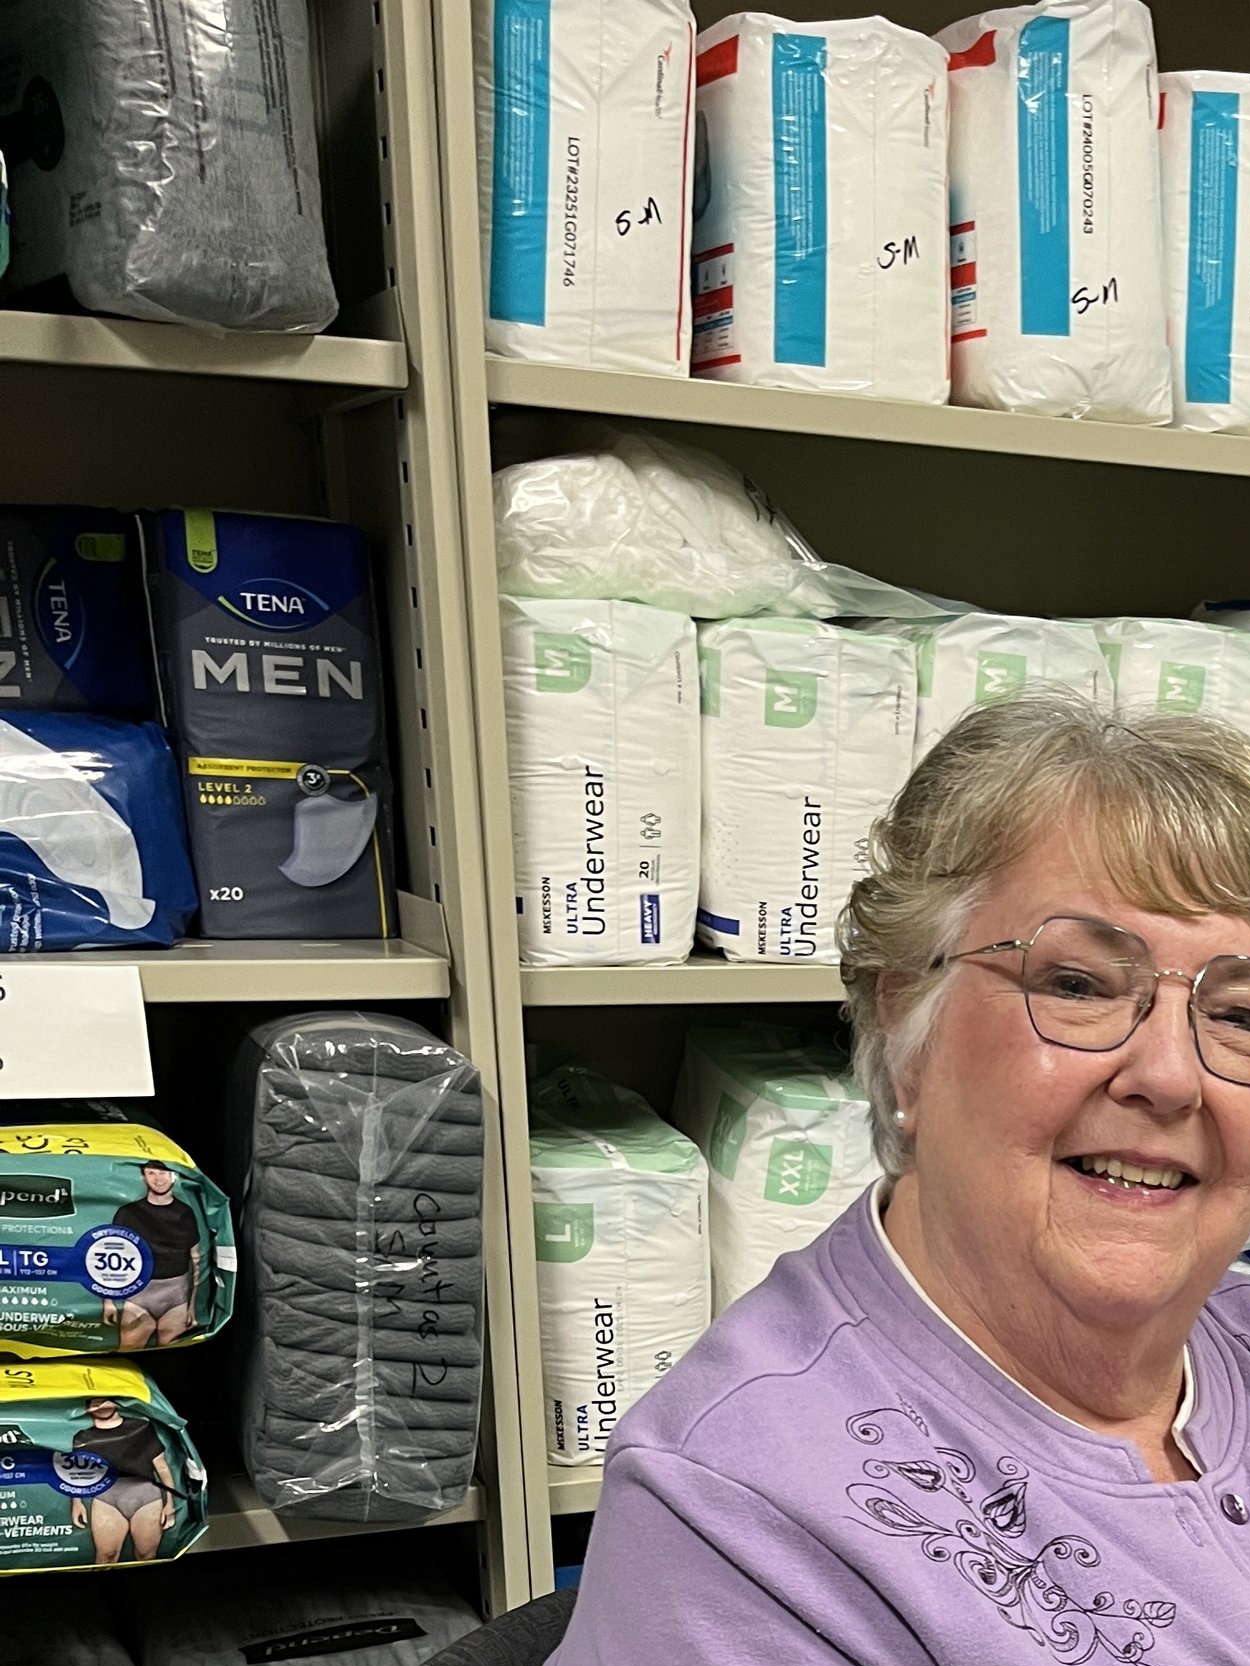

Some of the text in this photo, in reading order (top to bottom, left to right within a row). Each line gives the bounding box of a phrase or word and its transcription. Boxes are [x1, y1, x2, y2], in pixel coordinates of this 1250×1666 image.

[47, 581, 71, 642] TENA
[240, 592, 304, 614] TENA
[191, 649, 364, 700] MEN
[544, 649, 569, 676] M
[774, 684, 797, 712] M
[198, 782, 252, 793] LEVEL 2
[582, 766, 604, 935] Underwear
[639, 860, 650, 878] 20
[795, 796, 821, 956] Underwear
[210, 887, 243, 901] x20
[567, 882, 577, 934] ULTRA
[781, 906, 791, 955] ULTRA
[779, 1149, 803, 1196] XXL
[0, 1189, 62, 1206] pend
[546, 1223, 571, 1243] L
[19, 1251, 49, 1267] TG
[94, 1252, 136, 1272] 30x
[577, 1405, 588, 1450] ULTRA
